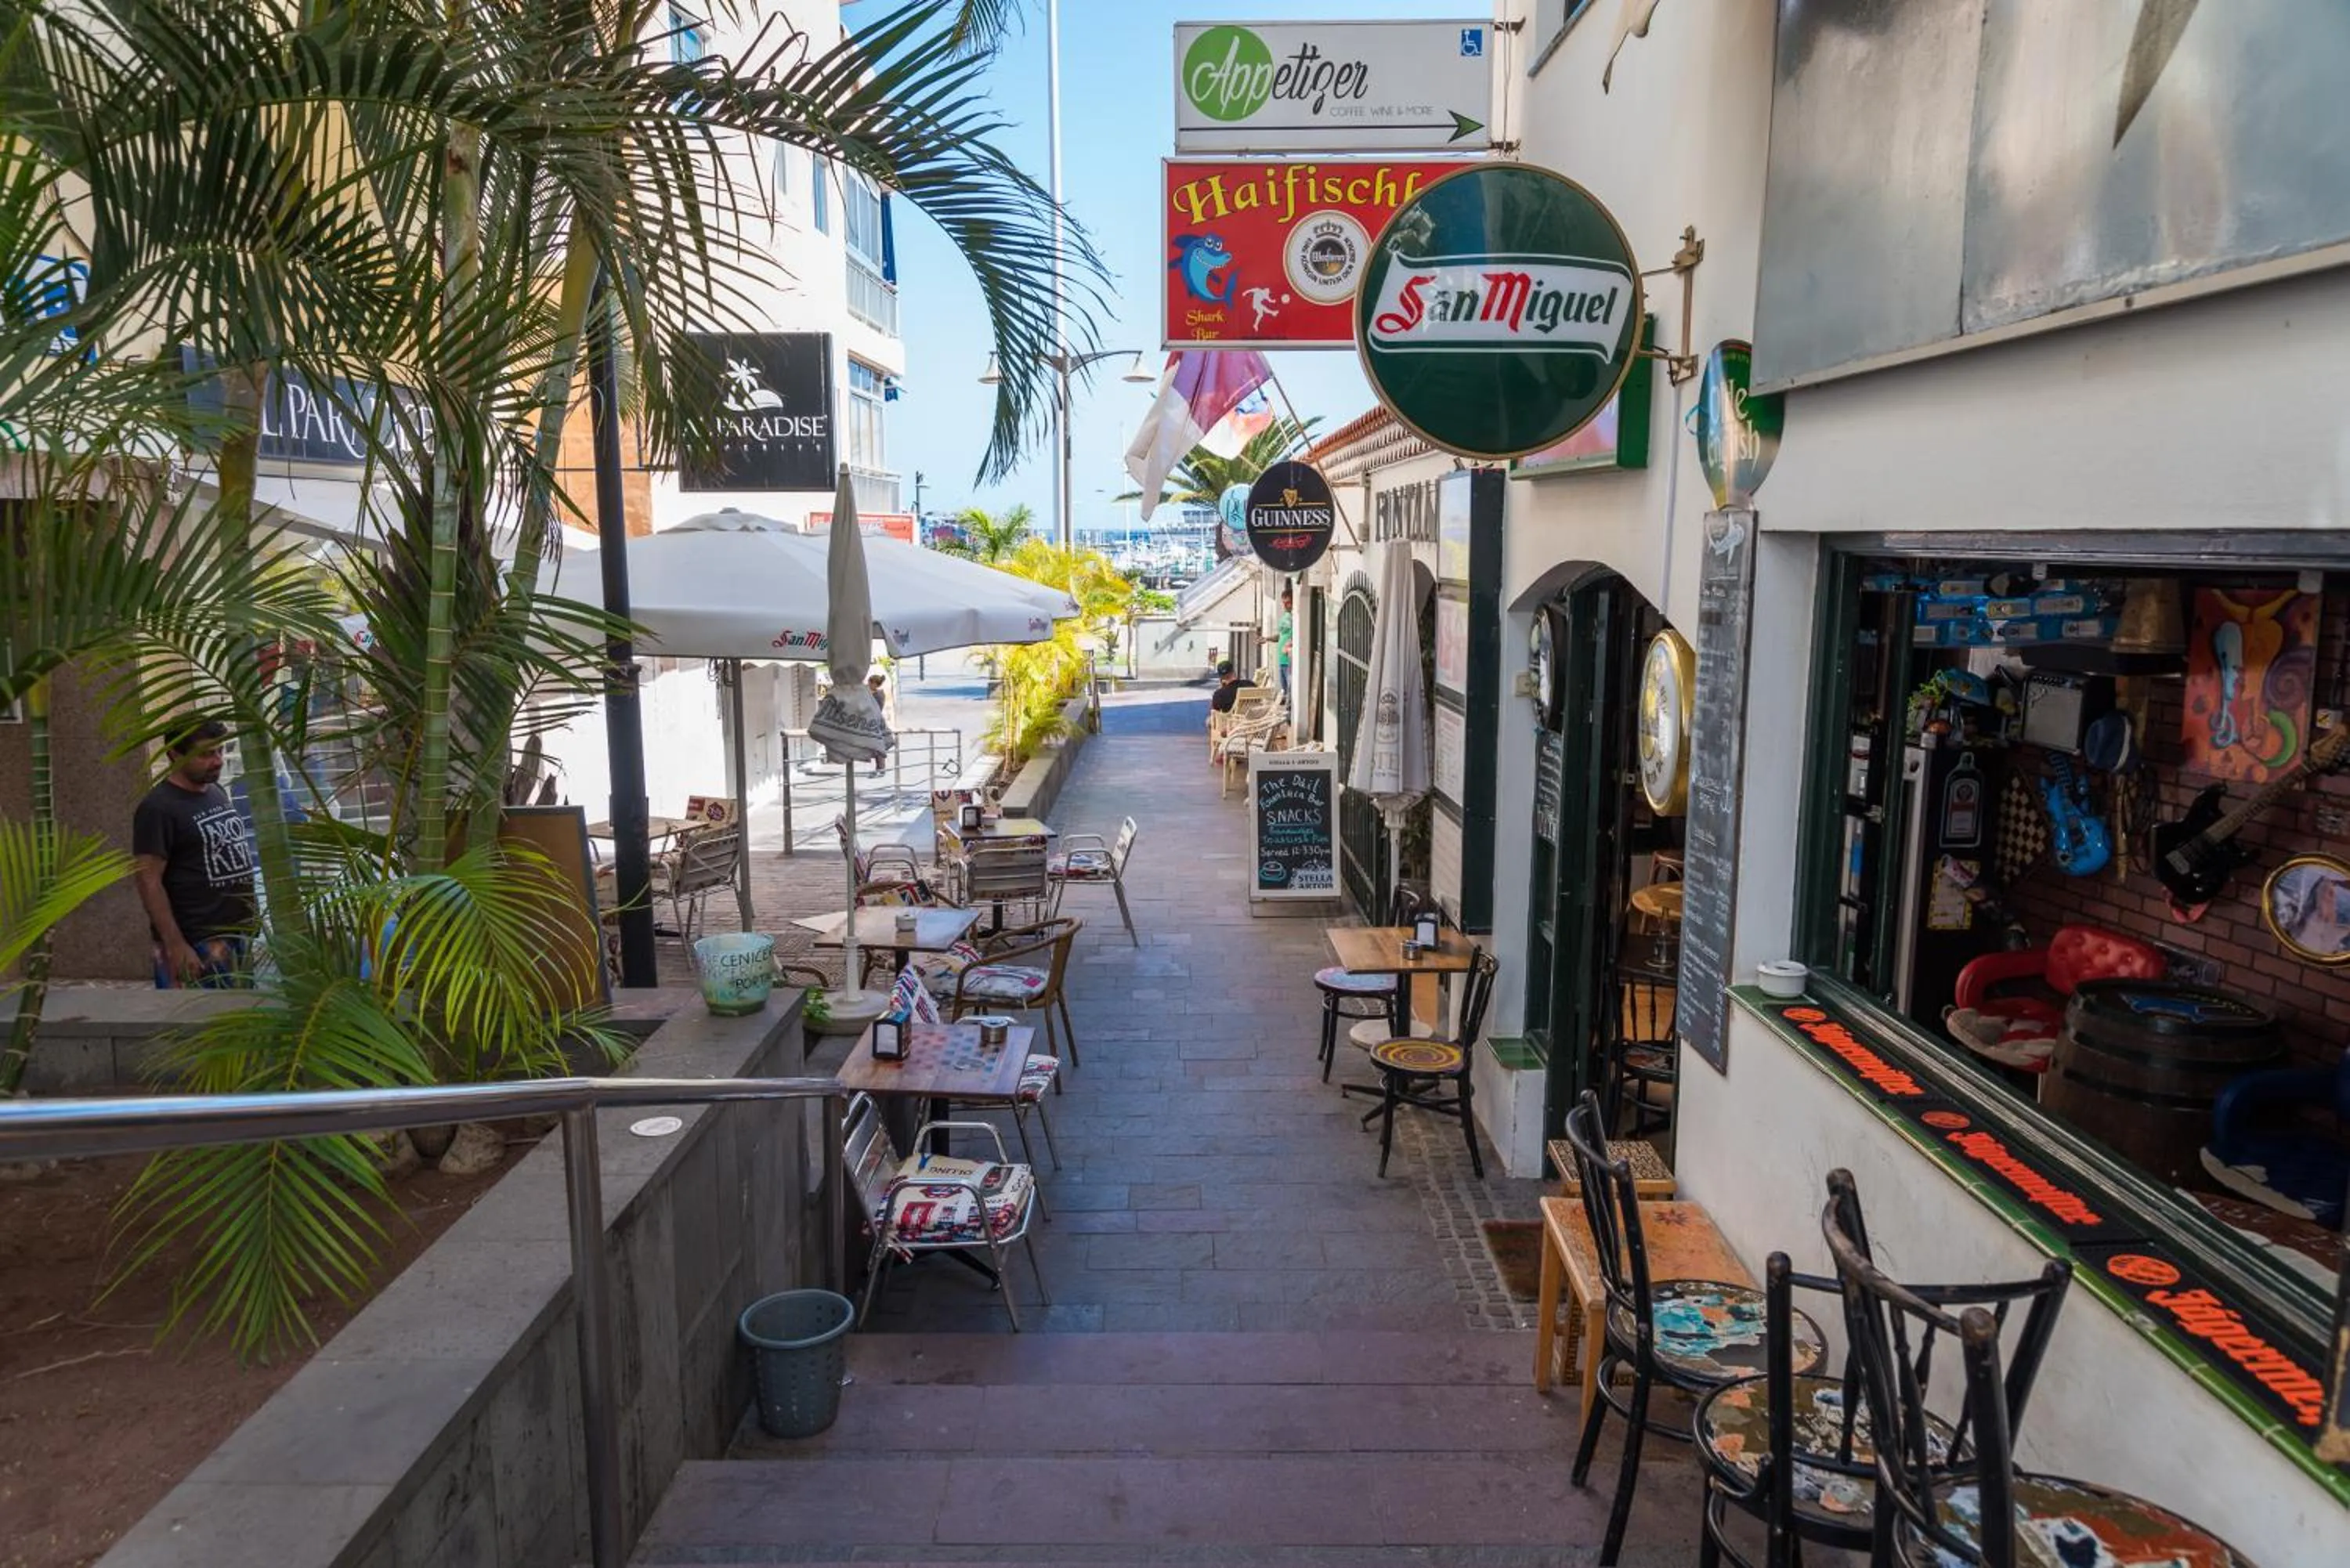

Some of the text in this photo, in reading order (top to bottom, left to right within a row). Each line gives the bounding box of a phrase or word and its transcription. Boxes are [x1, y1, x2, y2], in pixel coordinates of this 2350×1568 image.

[1191, 35, 1368, 115] Appetizer
[1330, 107, 1365, 117] COFFEE
[1371, 107, 1394, 116] WINE
[1406, 106, 1434, 115] MORE
[1185, 309, 1226, 327] Shark
[1191, 327, 1220, 341] Bar
[1251, 508, 1331, 528] GUINNESS
[804, 630, 828, 650] Mig
[1266, 808, 1323, 826] SNACKS
